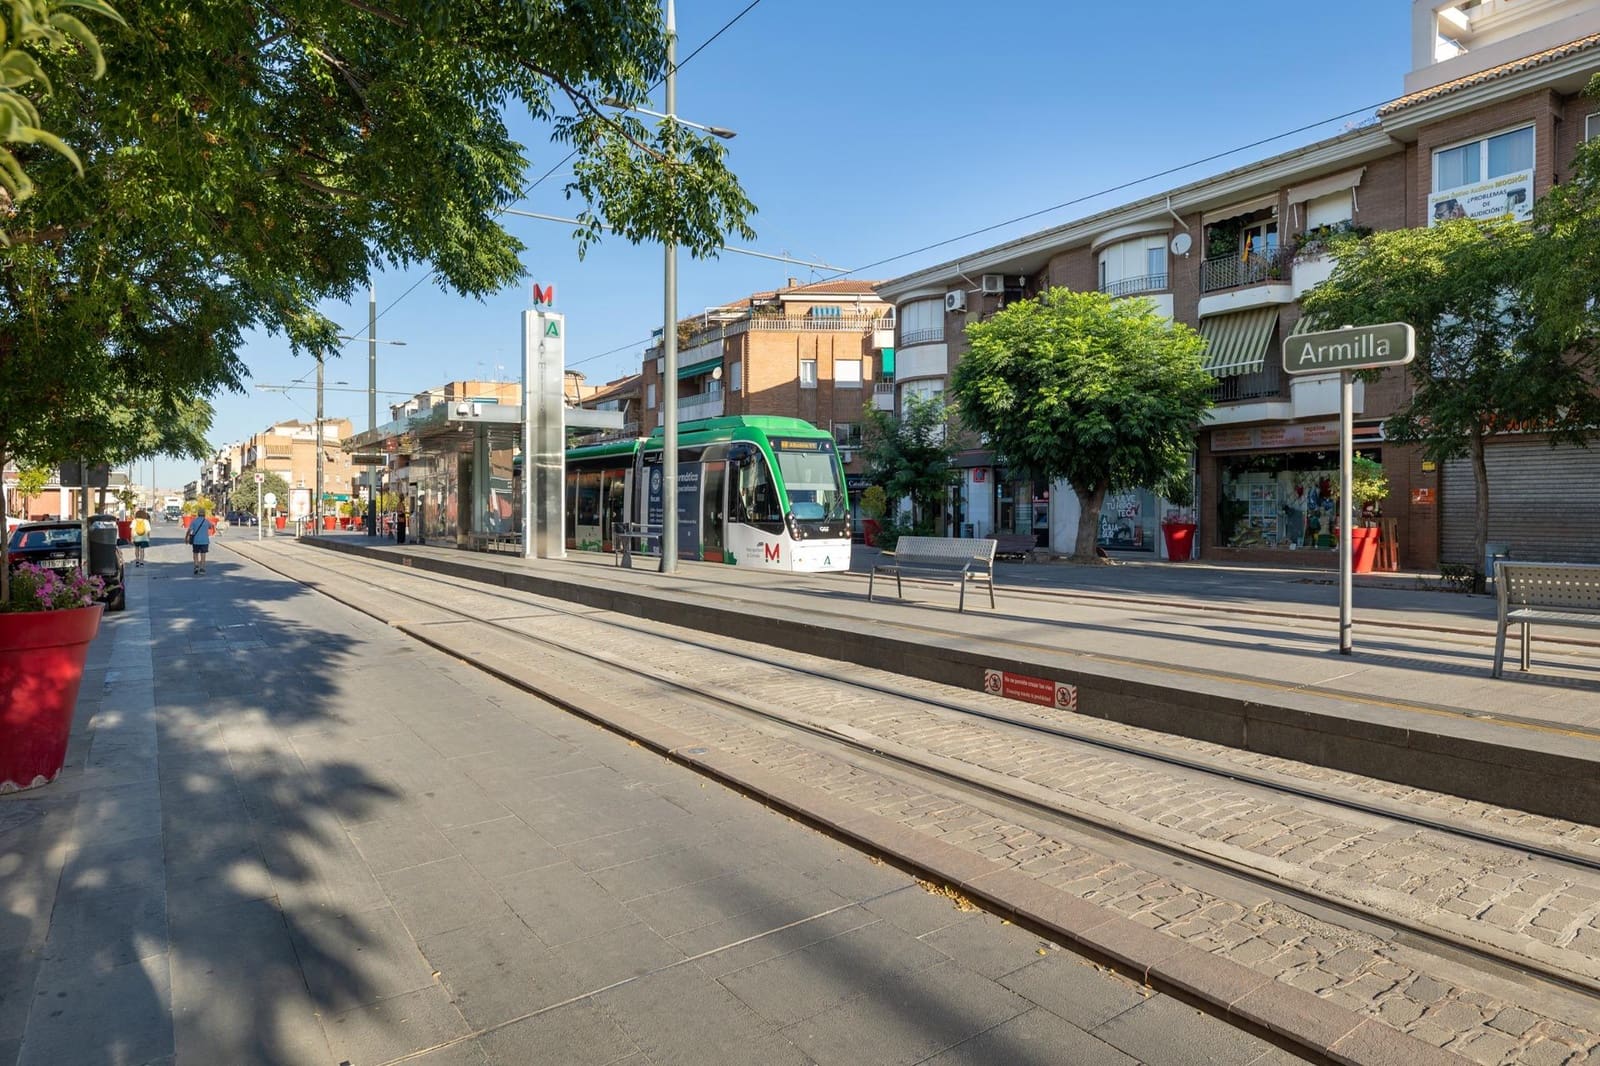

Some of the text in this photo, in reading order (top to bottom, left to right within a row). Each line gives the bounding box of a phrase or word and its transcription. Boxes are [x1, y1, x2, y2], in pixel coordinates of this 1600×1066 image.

[1467, 189, 1507, 204] ¿PROBLEMAS
[1482, 200, 1491, 208] DE
[1471, 206, 1504, 217] AUDICIÓN?
[533, 283, 552, 306] M
[1299, 333, 1390, 365] Armilla
[765, 543, 780, 563] M
